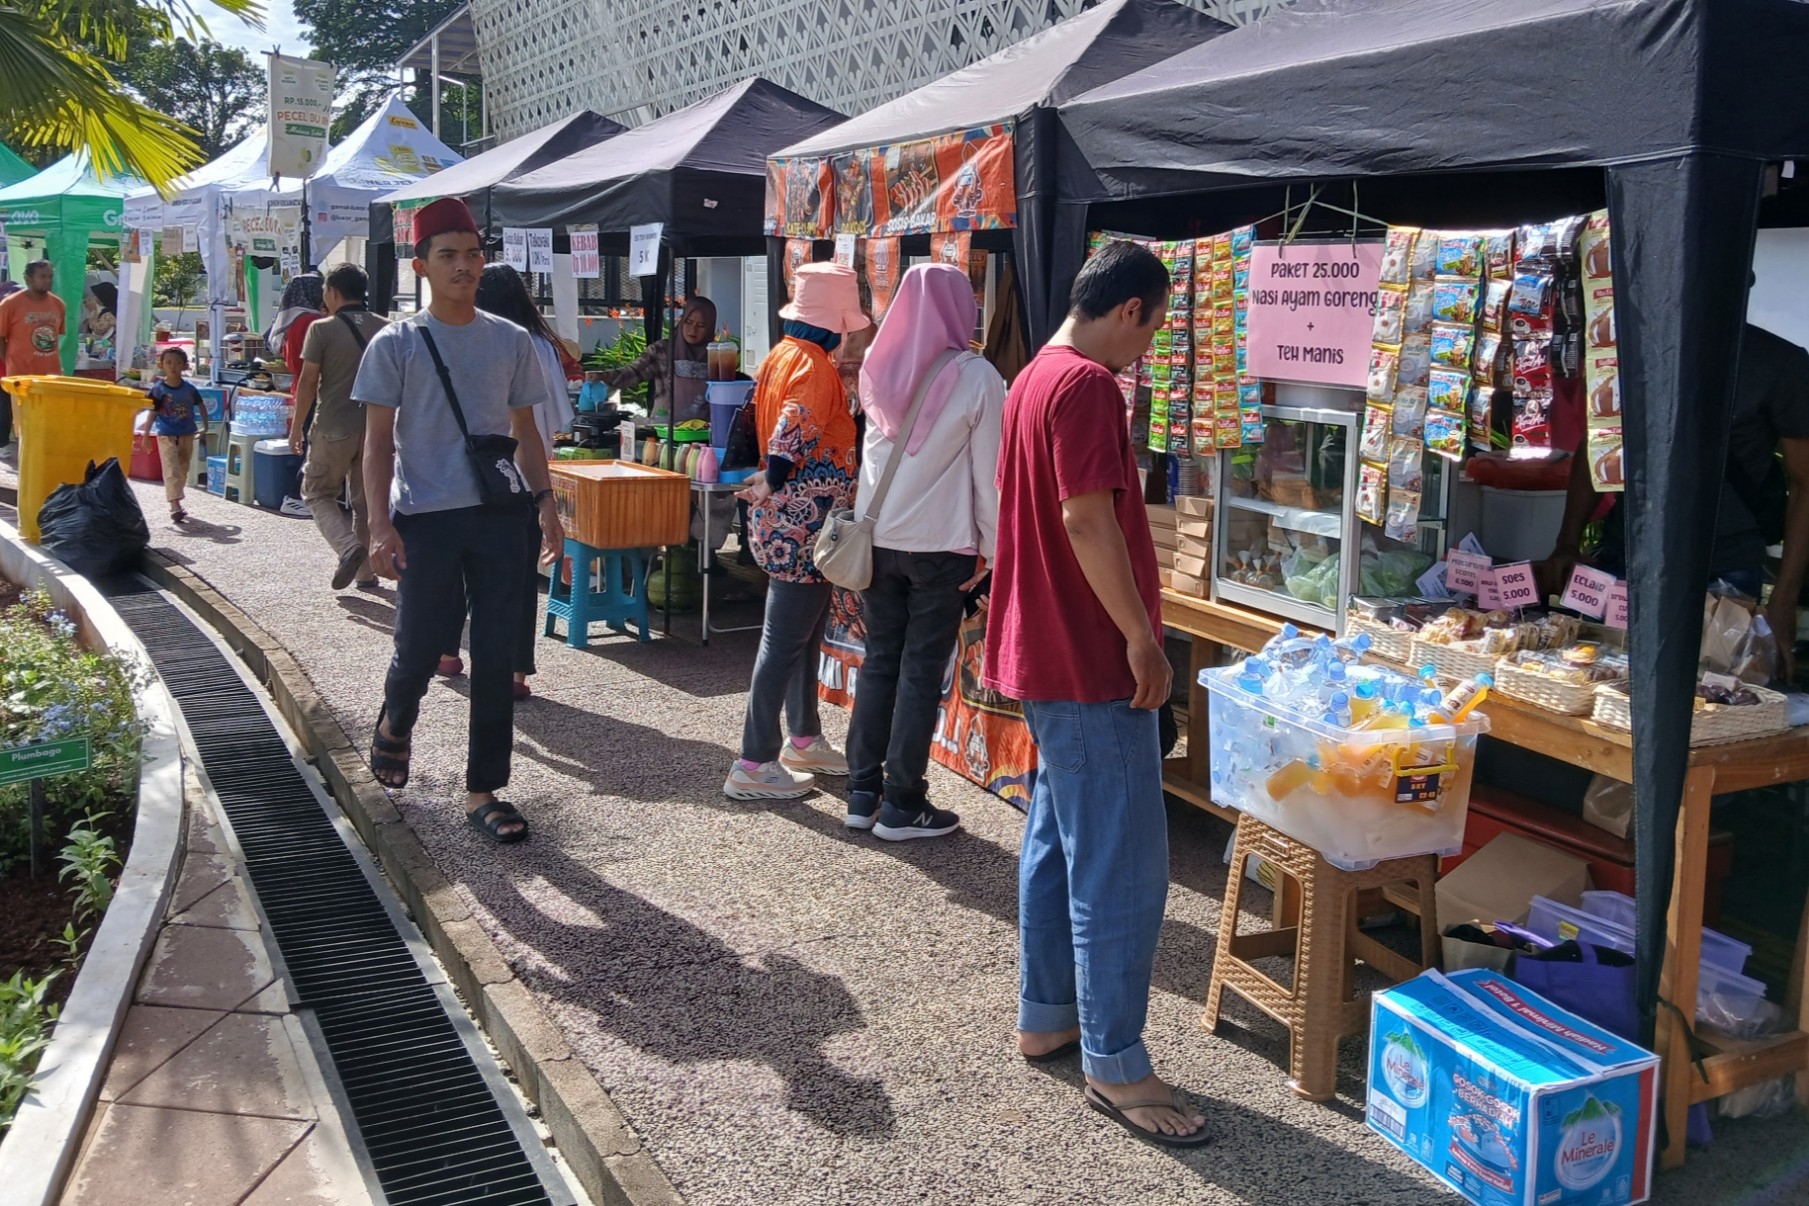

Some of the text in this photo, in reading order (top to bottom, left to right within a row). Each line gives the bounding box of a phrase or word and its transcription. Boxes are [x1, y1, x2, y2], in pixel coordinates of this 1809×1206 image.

[277, 111, 307, 121] PECEL
[310, 113, 321, 124] BU
[571, 235, 598, 251] KEBAB
[580, 254, 598, 273] 10.000
[639, 250, 650, 263] 5 K
[1312, 262, 1360, 279] 25.000
[1252, 290, 1278, 305] Nasi
[1281, 290, 1320, 312] Ayam
[1303, 346, 1344, 365] Manis
[1503, 587, 1530, 600] 5.000
[1571, 590, 1599, 607] 5.000
[12, 748, 61, 762] Plumbago
[1487, 984, 1608, 1051] Hadiah Minimal 1 Botol
[1399, 1055, 1411, 1069] Le
[1386, 1057, 1425, 1091] Minerale
[1453, 1073, 1521, 1124] GOSOK-GOSOK
[1457, 1088, 1514, 1131] BERHADIAH
[1581, 1131, 1596, 1147] Le
[1562, 1140, 1615, 1166] Minerale
